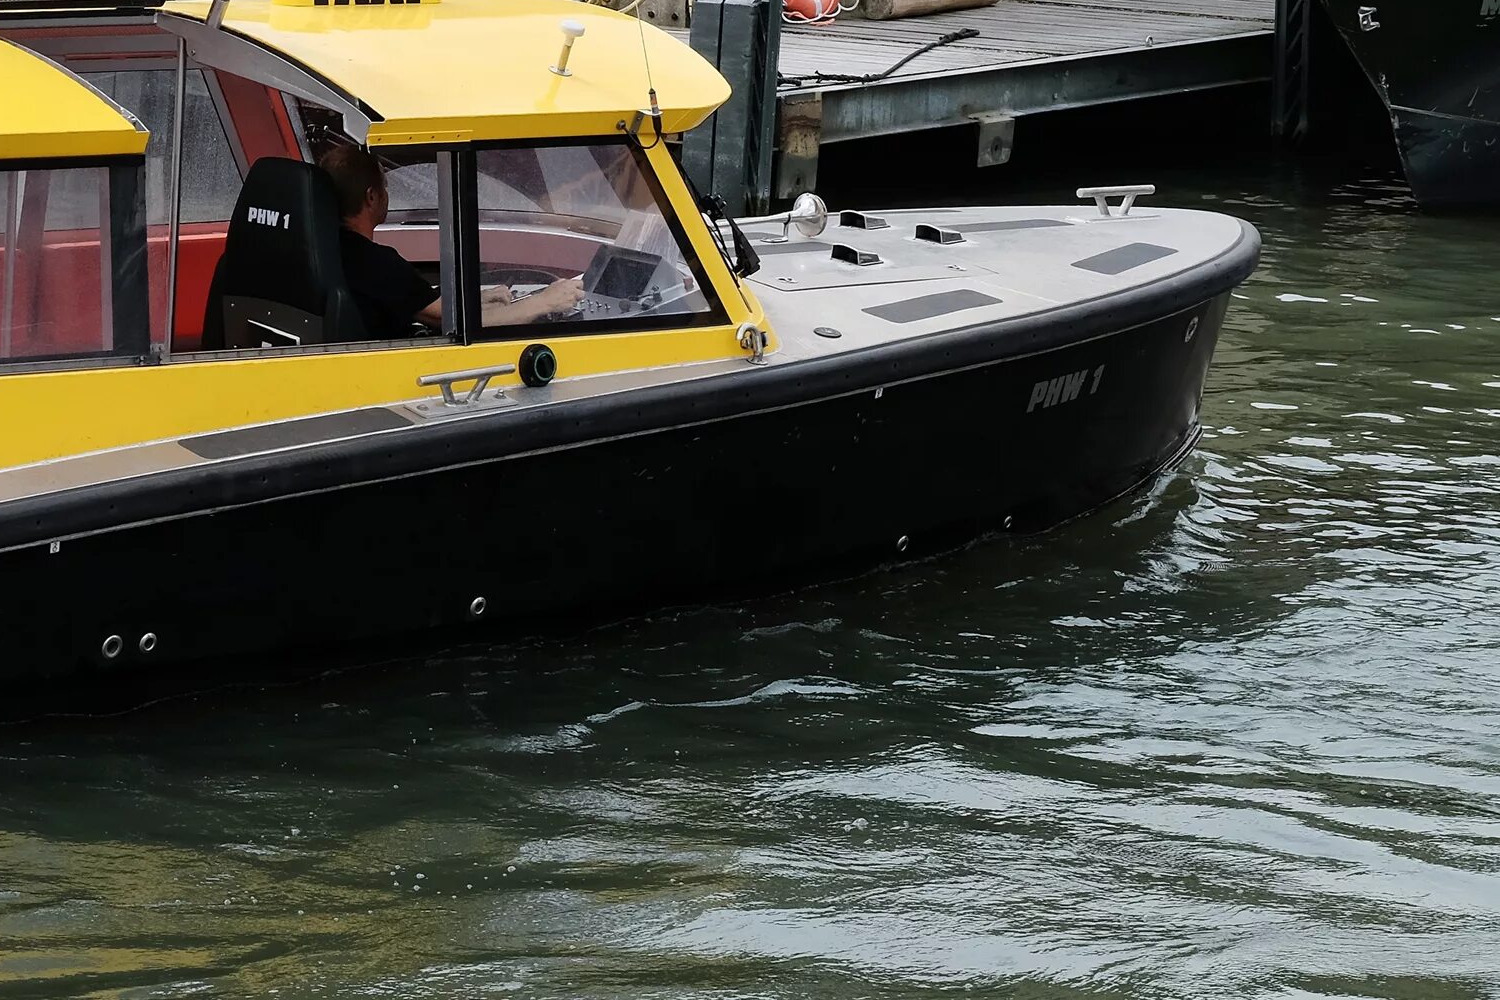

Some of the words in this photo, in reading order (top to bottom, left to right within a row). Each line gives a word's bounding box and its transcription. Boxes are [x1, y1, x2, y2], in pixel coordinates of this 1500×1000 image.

[247, 206, 280, 227] PHW
[283, 213, 290, 230] 1
[1026, 368, 1089, 414] PHW
[1089, 363, 1105, 395] 1
